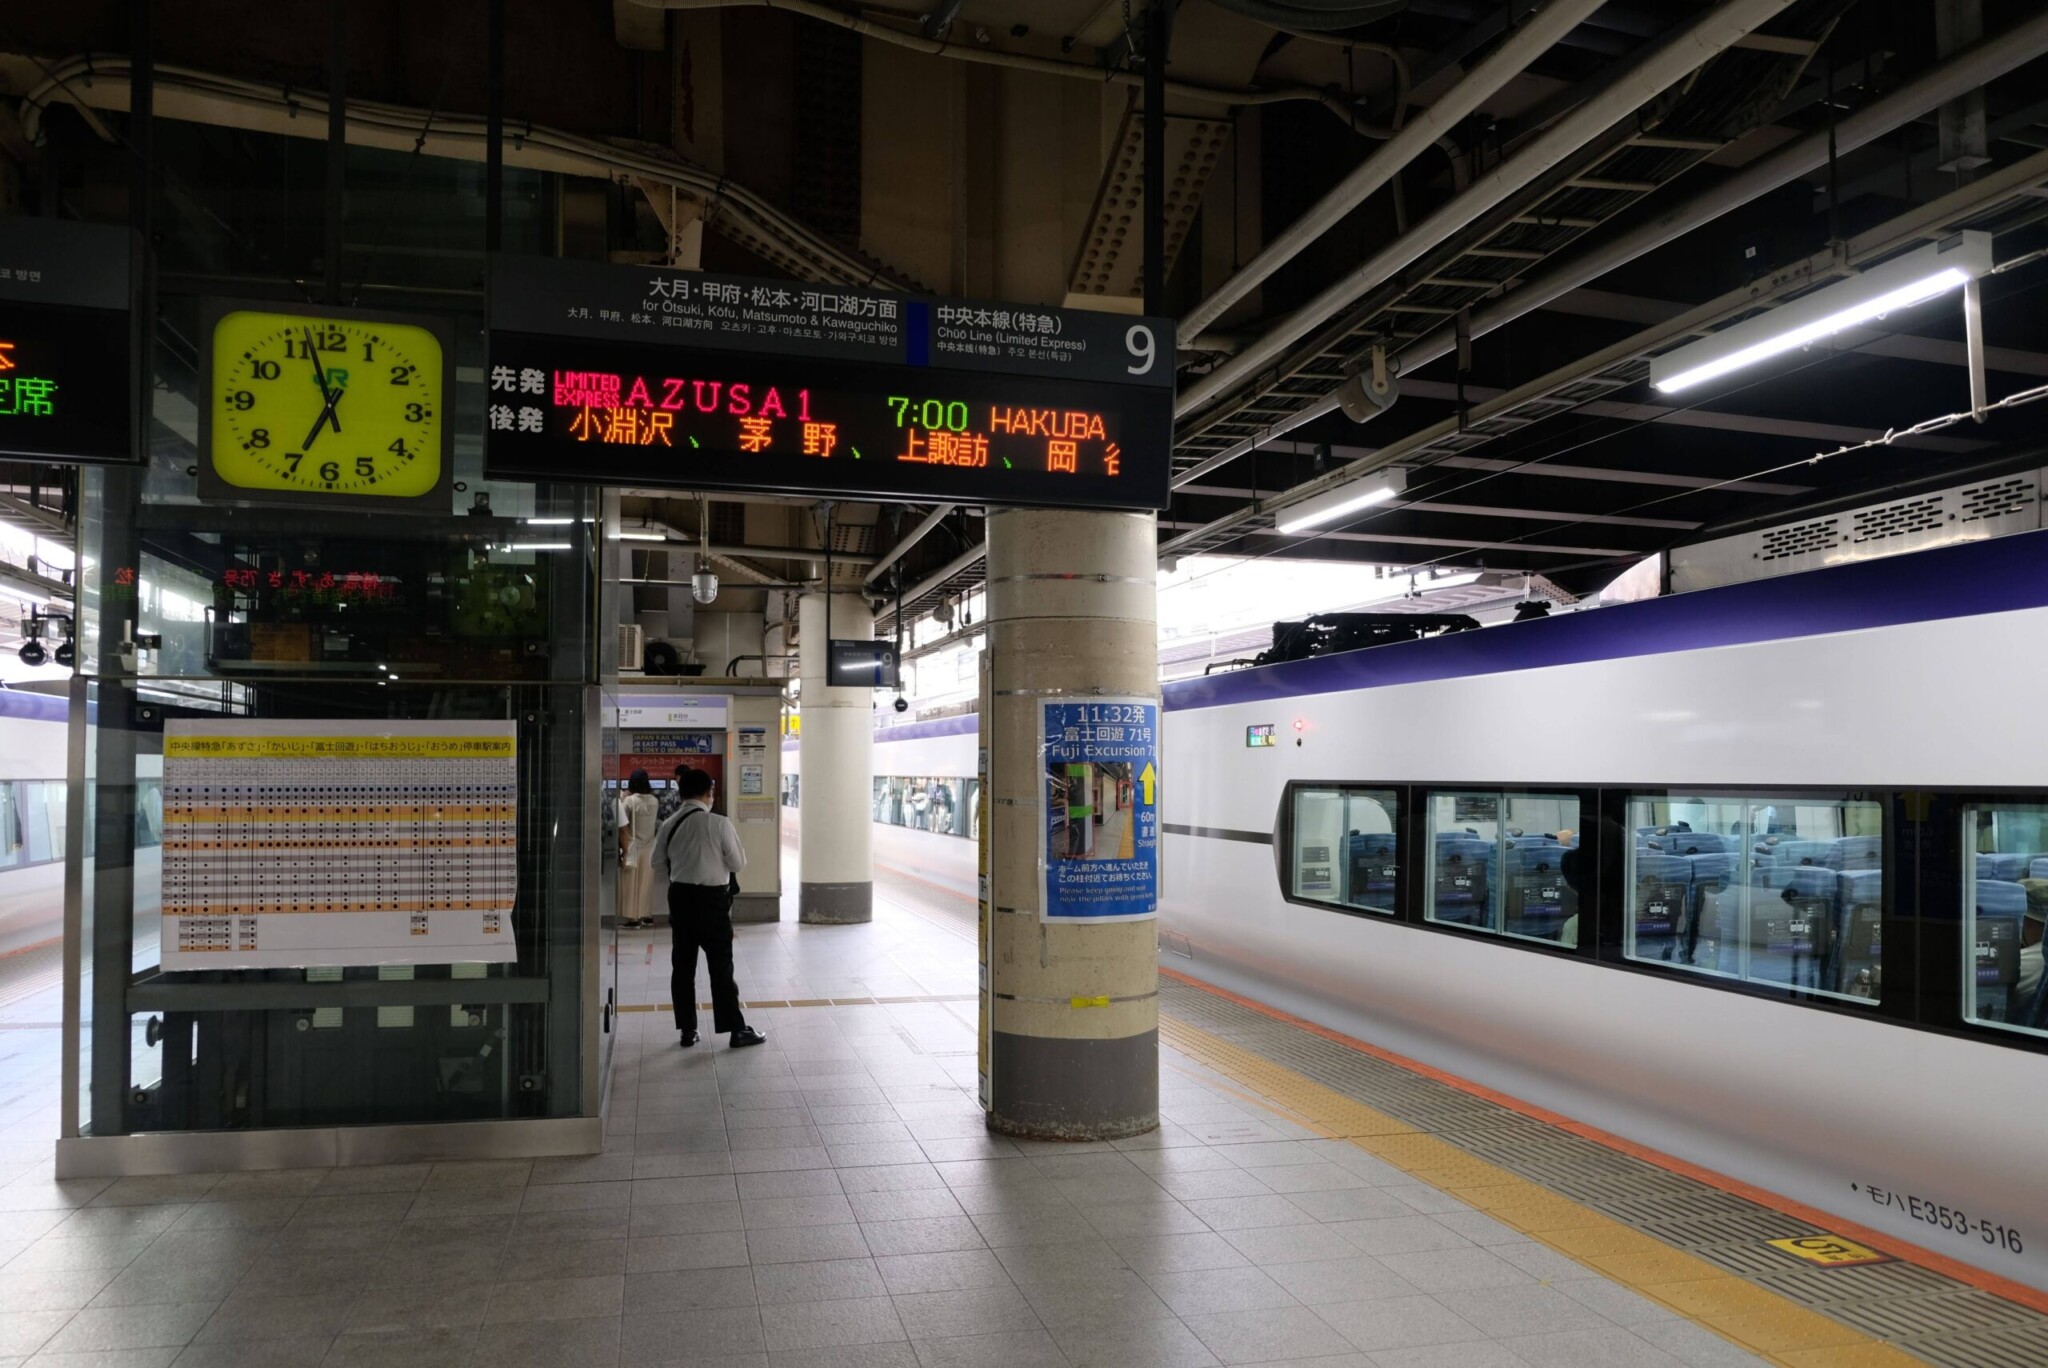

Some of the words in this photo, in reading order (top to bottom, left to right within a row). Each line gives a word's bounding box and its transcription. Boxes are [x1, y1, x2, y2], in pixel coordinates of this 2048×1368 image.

[649, 277, 898, 319] 大月・甲府・松本・河口湖方面
[643, 299, 659, 312] for
[743, 308, 807, 325] Matsumoto
[810, 314, 820, 326] &
[823, 316, 898, 334] Kawaguchiko
[316, 332, 347, 353] 12
[970, 330, 993, 342] Line
[995, 332, 1038, 347] (Limited
[1041, 336, 1087, 351] Express)
[1124, 324, 1157, 375] 9
[363, 342, 375, 362] 1
[251, 359, 281, 381] 10
[390, 366, 410, 386] 2
[491, 365, 546, 395] 先発
[554, 370, 622, 391] LIMITED
[234, 390, 255, 411] 9
[554, 387, 620, 408] EXPRESS
[404, 403, 424, 423] 3
[488, 403, 544, 433] 後発
[888, 396, 968, 432] 7:00
[991, 406, 1105, 440] HAKUBA
[249, 428, 271, 449] 8
[387, 437, 408, 457] 4
[284, 453, 303, 473] 7
[320, 462, 340, 482] 6
[355, 456, 375, 477] 5
[882, 652, 893, 669] 9
[1077, 705, 1145, 724] 11:32発
[1064, 726, 1125, 742] 富士回遊
[1129, 727, 1151, 742] 71号
[1052, 744, 1080, 759] Fuji
[1085, 744, 1145, 756] Excursion
[1866, 1184, 2024, 1255] モハE353-516
